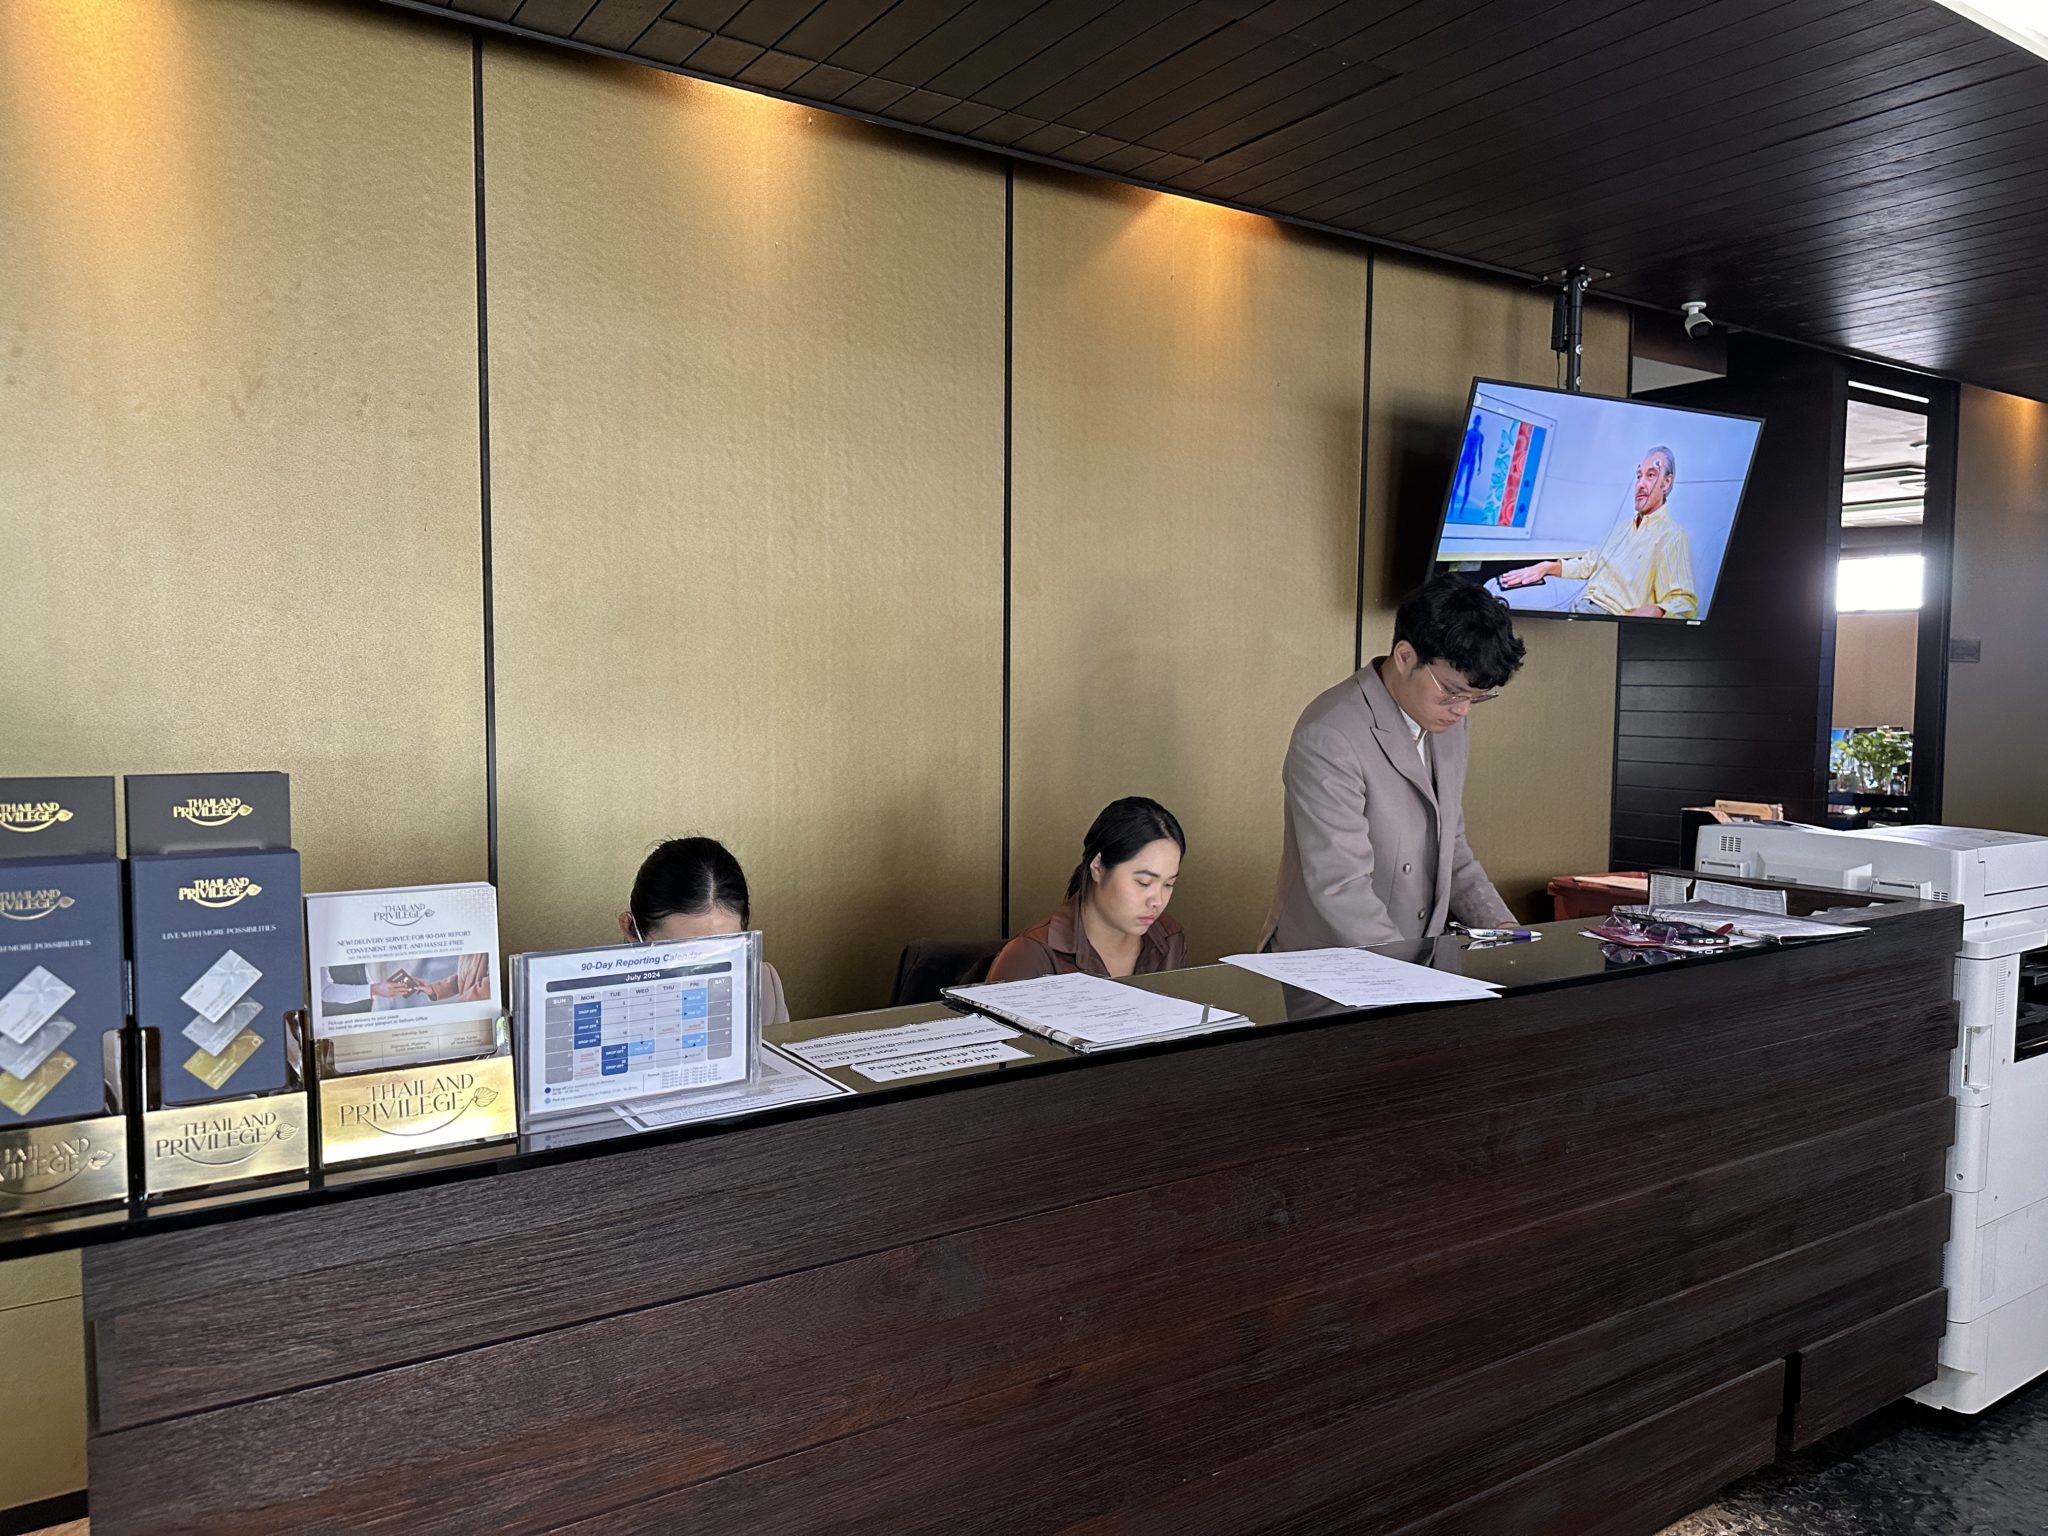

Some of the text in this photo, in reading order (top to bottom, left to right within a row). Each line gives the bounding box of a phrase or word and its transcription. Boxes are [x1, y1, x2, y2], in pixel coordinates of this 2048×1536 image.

[187, 797, 242, 808] THAILAND
[0, 810, 55, 823] IVILEGE
[173, 804, 237, 818] PRIVILEGE
[193, 877, 250, 890] THAILAND
[178, 885, 244, 901] PRIVILEGE
[0, 898, 55, 911] IVILEGE
[384, 903, 426, 914] THAILAND
[373, 910, 422, 921] PRIVILEGE
[162, 924, 277, 940] LIVE WITH MORE POSSIBILITIES
[354, 937, 384, 946] DELIVERY
[385, 935, 411, 943] SERVICE
[447, 930, 472, 938] REPORT
[409, 942, 424, 950] AND
[581, 960, 614, 971] 90-Day
[615, 955, 661, 968] Reporting
[625, 971, 661, 982] July 2024
[868, 1045, 1001, 1072] Passport Pick-up Time
[891, 1064, 928, 1076] 13.00
[367, 1073, 474, 1102] THAILAND
[340, 1092, 466, 1127] PRIVILEGE
[183, 1111, 277, 1137] THAILAND
[0, 1138, 90, 1165] HAILAND
[155, 1128, 270, 1160] PRIVILEGE
[0, 1154, 80, 1183] VILEGE
